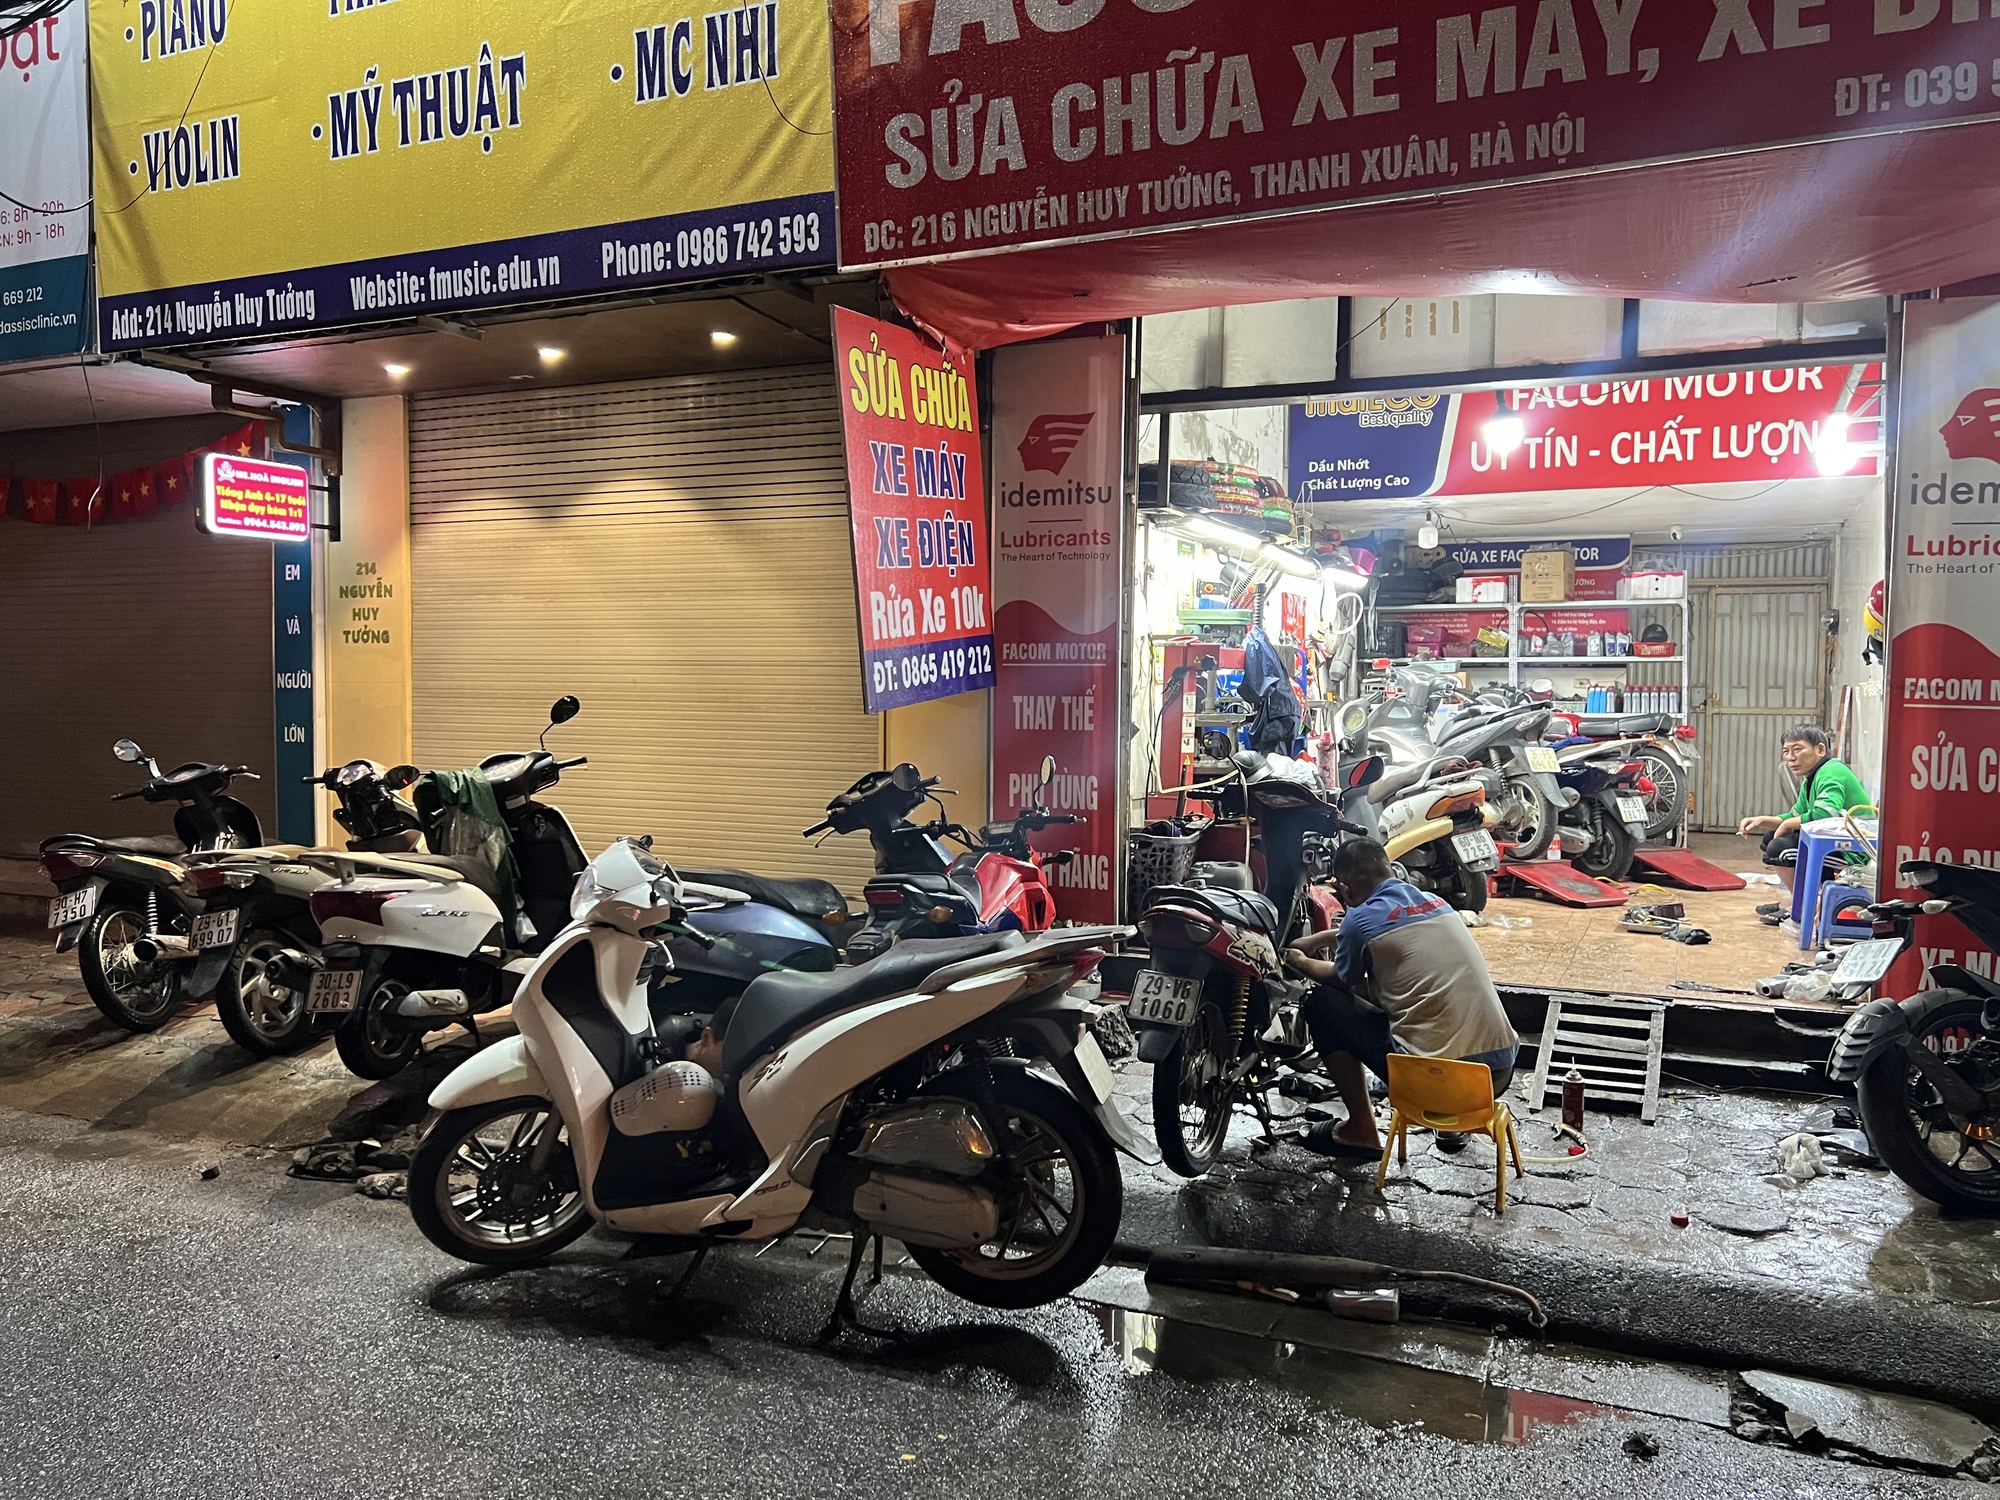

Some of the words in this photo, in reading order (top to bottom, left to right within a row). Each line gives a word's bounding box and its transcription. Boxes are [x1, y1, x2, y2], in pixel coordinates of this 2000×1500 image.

[140, 0, 229, 62] PIANO
[0, 16, 60, 83] ạt
[634, 17, 692, 104] MC
[704, 2, 780, 89] NHI
[328, 65, 383, 160] MỸ
[392, 41, 527, 155] THUẬT
[1834, 77, 1892, 118] ĐT:
[1904, 61, 1978, 110] 039
[884, 78, 1028, 190] SỬA
[1050, 46, 1264, 164] CHỮA
[1291, 26, 1401, 128] XE
[144, 116, 240, 193] VIOLIN
[864, 221, 904, 254] ĐC:
[911, 208, 957, 248] 216
[964, 184, 1069, 240] NGUYỄN
[1077, 186, 1131, 225] HUY
[1137, 164, 1243, 216] TƯỞNG,
[1250, 154, 1352, 199] THANH
[1361, 134, 1459, 185] XUÂN,
[1470, 121, 1514, 169] HÀ
[1526, 111, 1586, 164] NỘI
[13, 206, 29, 223] 8h
[17, 228, 32, 245] 9h
[45, 222, 65, 240] 18h
[602, 237, 672, 280] Phone:
[676, 227, 728, 270] 0986
[733, 220, 775, 261] 742
[779, 212, 821, 255] 593
[350, 273, 427, 312] Website:
[429, 256, 561, 302] fmusic.edu.vn
[3, 289, 24, 306] 669
[26, 286, 44, 303] 212
[111, 309, 143, 342] Add:
[145, 303, 174, 337] 214
[176, 290, 232, 334] Nguyễn
[234, 292, 264, 331] Huy
[266, 283, 316, 322] Tưởng
[848, 330, 907, 422] SỬA
[910, 360, 974, 433] CHỮA
[1511, 379, 1649, 411] FACOM
[1663, 366, 1825, 401] MOTOR
[1361, 413, 1388, 426] Best
[1390, 409, 1432, 425] quality
[1523, 427, 1578, 470] TÍN
[1610, 415, 1702, 465] CHẤT
[1712, 418, 1826, 464] LƯỢN
[869, 440, 909, 497] XE
[912, 440, 967, 501] MÁY
[1308, 461, 1334, 473] Dầu
[1337, 458, 1370, 472] Nhớt
[1001, 479, 1112, 508] idemitsu
[1309, 476, 1337, 491] Chất
[1340, 476, 1382, 491] Lượng
[1384, 475, 1410, 487] Cao
[244, 489, 263, 501] Anh
[264, 492, 287, 503] 4-17
[873, 516, 912, 570] XE
[916, 509, 976, 578] ĐIỆN
[1001, 530, 1111, 548] Lubricants
[1002, 553, 1018, 562] The
[1019, 552, 1045, 562] Heart
[1046, 552, 1056, 561] of
[1057, 550, 1111, 564] Technology
[1452, 548, 1478, 563] SỬA
[1481, 550, 1498, 563] XE
[285, 564, 300, 581] EM
[356, 562, 377, 575] 214
[1907, 563, 1933, 573] The
[1936, 563, 1976, 574] Heart
[1979, 563, 1994, 574] of
[339, 577, 393, 598] NGUYỄN
[352, 607, 379, 621] HUY
[869, 583, 916, 641] Rửa
[919, 587, 947, 635] Xe
[950, 585, 986, 631] 10k
[286, 615, 300, 635] VÀ
[343, 624, 390, 643] TƯỞNG
[1002, 643, 1052, 660] FACOM
[1055, 643, 1107, 660] MOTOR
[277, 670, 311, 689] NGƯỜI
[873, 659, 899, 694] ĐT:
[901, 653, 939, 690] 0865
[940, 648, 966, 681] 419
[967, 644, 992, 676] 212
[1904, 677, 1982, 701] FACOM
[1012, 695, 1057, 730] THAY
[1061, 684, 1095, 731] THẾ
[284, 724, 305, 742] LỚN
[1910, 730, 1969, 792] SỬA
[1052, 767, 1099, 811] TÙNG
[1463, 843, 1492, 860] 7253
[54, 891, 88, 911] 30-H7
[53, 904, 87, 927] 7350
[316, 973, 354, 990] 30-L9
[312, 992, 351, 1010] 2603
[1140, 997, 1187, 1022] 1060
